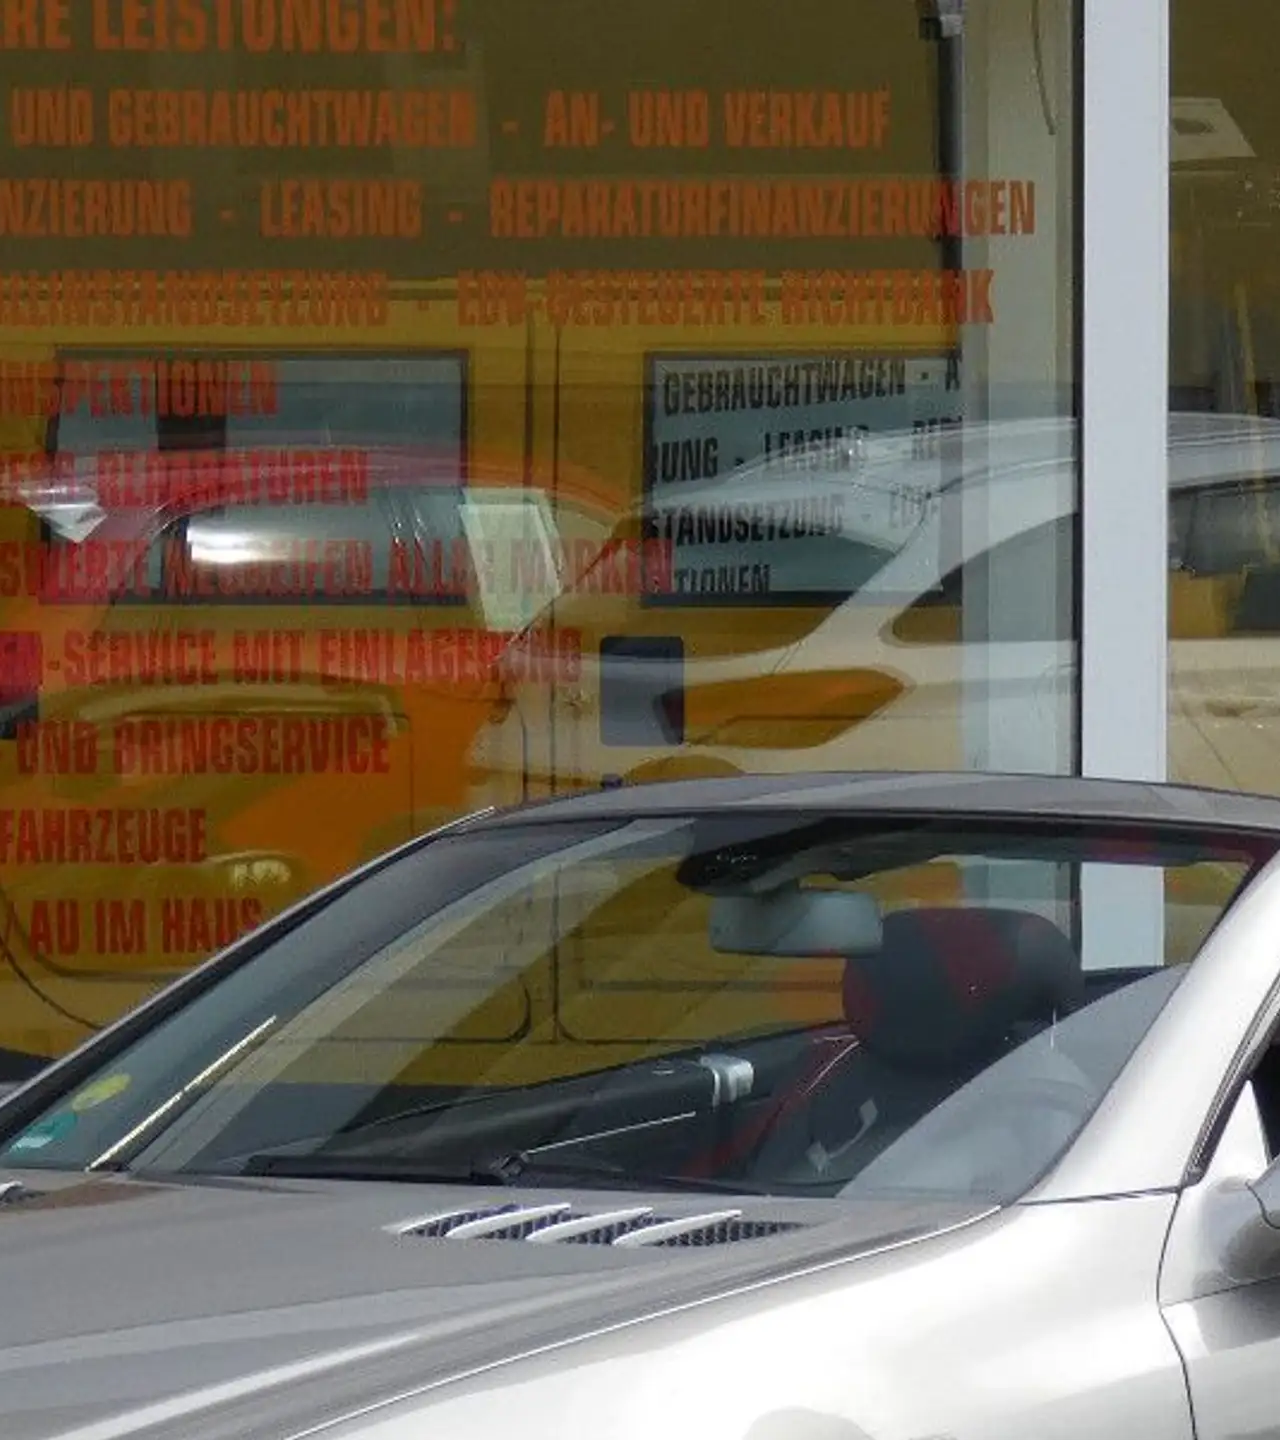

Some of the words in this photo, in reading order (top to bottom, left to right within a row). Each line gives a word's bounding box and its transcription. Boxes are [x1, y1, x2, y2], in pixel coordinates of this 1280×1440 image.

[92, 0, 456, 50] LEISTUNGEN!
[11, 89, 93, 146] UND
[108, 89, 477, 147] GEBRAUCHTWAGEN
[544, 90, 614, 147] AN-
[630, 91, 709, 148] UND
[724, 89, 891, 148] VERKAUF
[260, 180, 422, 237] LEASING
[490, 180, 1035, 237] REPARATURFINANZIERUNGEN
[663, 359, 906, 417] GEBRAUCHTWAGEN
[232, 631, 306, 686] MIT
[17, 716, 99, 775] UND
[114, 713, 391, 775] BRINGSERVICE
[29, 899, 80, 954] AU
[95, 899, 147, 954] IM
[163, 898, 266, 953] HAUS
